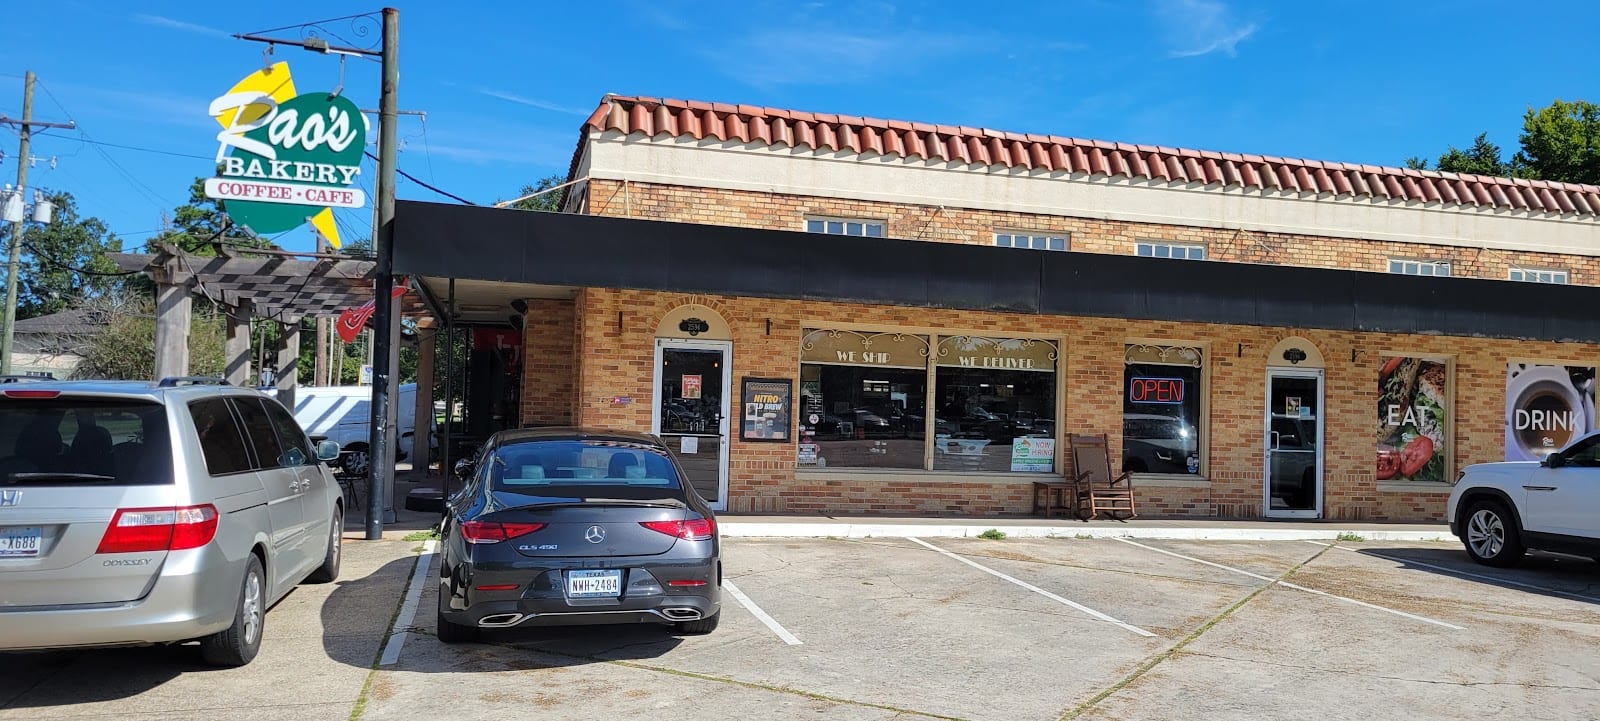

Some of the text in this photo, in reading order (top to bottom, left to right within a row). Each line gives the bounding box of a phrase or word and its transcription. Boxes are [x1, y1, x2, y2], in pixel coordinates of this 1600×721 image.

[209, 90, 357, 163] Rao's
[223, 157, 361, 184] BAKERY
[218, 182, 353, 204] COFFEE CAFE
[836, 350, 891, 364] WE SHIP
[958, 355, 1035, 369] WE DELIVER
[1132, 379, 1182, 401] OPEN
[753, 394, 779, 404] NITRO
[764, 403, 782, 411] BREW
[1388, 404, 1430, 427] EAT
[1515, 409, 1581, 432] DRINK
[1035, 441, 1051, 449] NOW
[1031, 449, 1054, 457] HIRING
[8, 535, 36, 549] X688
[102, 558, 153, 567] ODYSSEY
